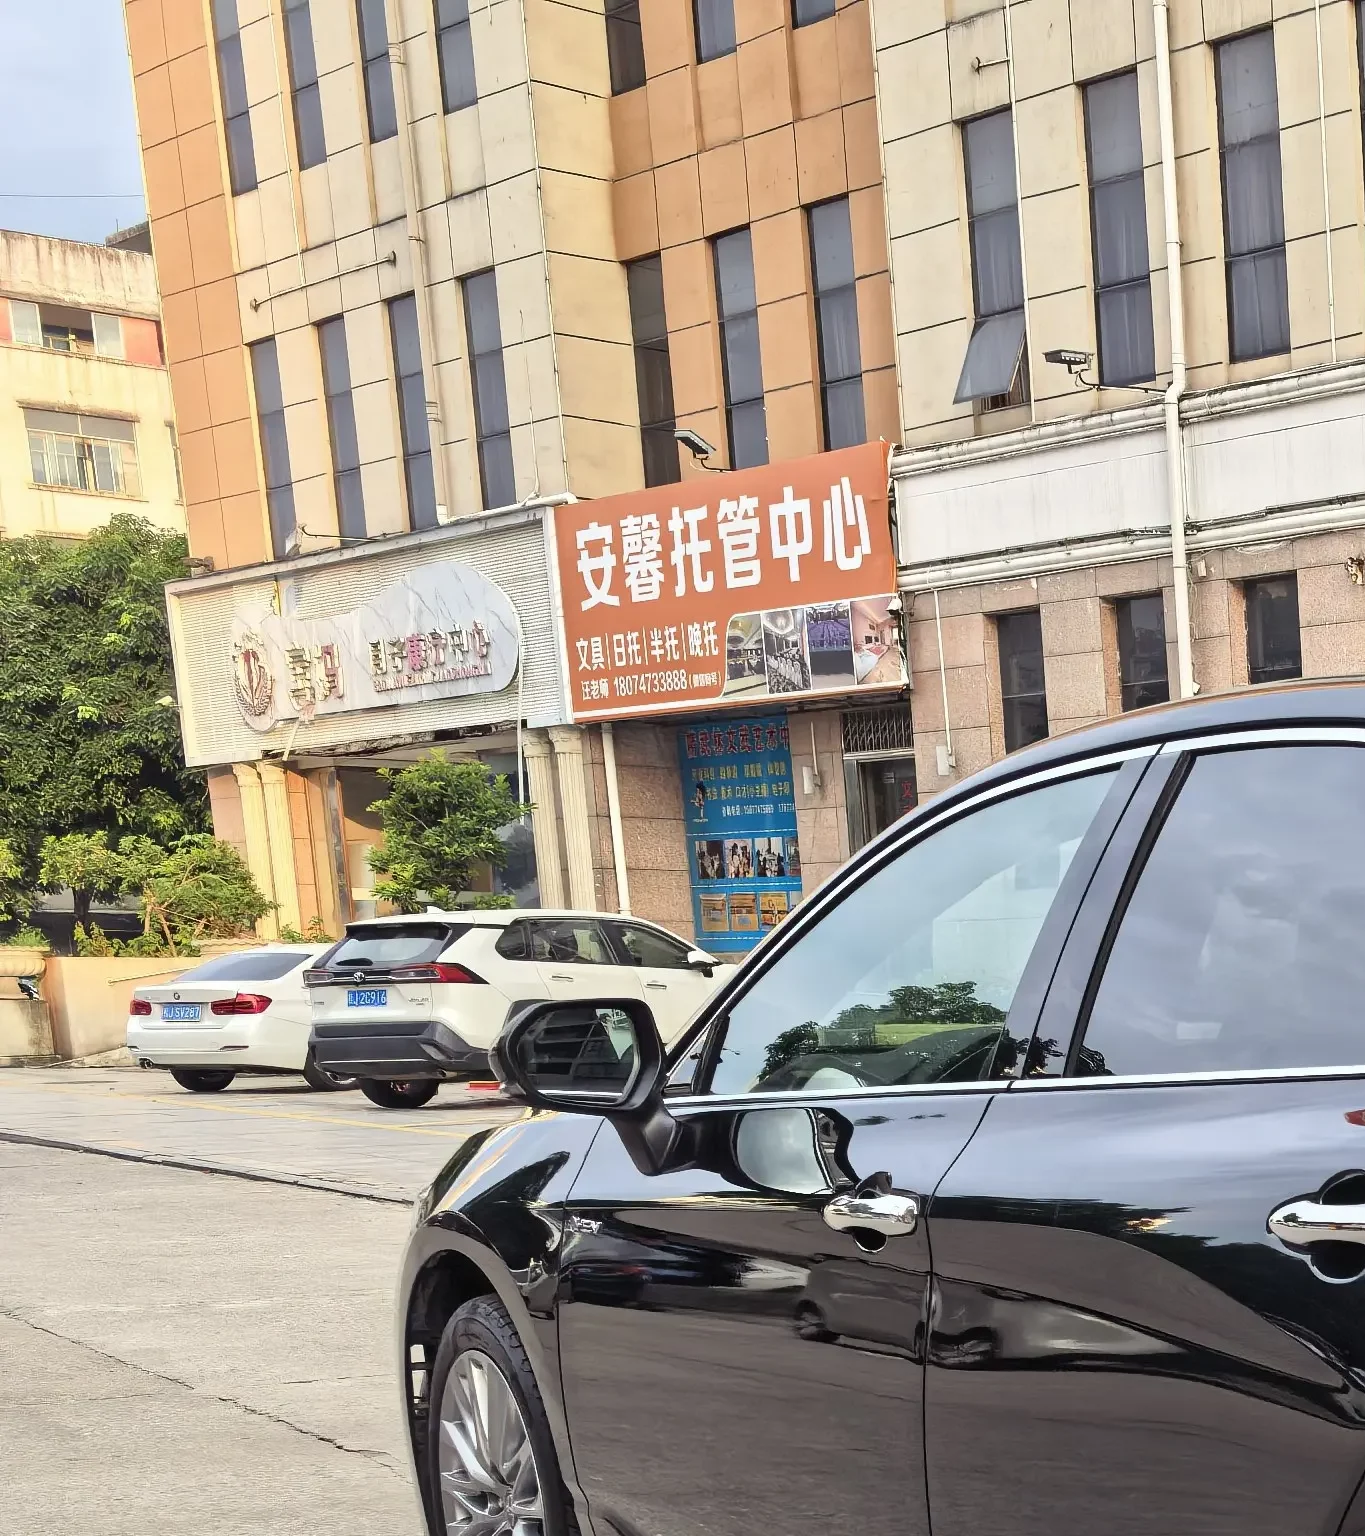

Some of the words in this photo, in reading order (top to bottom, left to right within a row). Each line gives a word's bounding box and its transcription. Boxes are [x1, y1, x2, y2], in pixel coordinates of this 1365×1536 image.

[575, 476, 871, 612] 安馨托管中心
